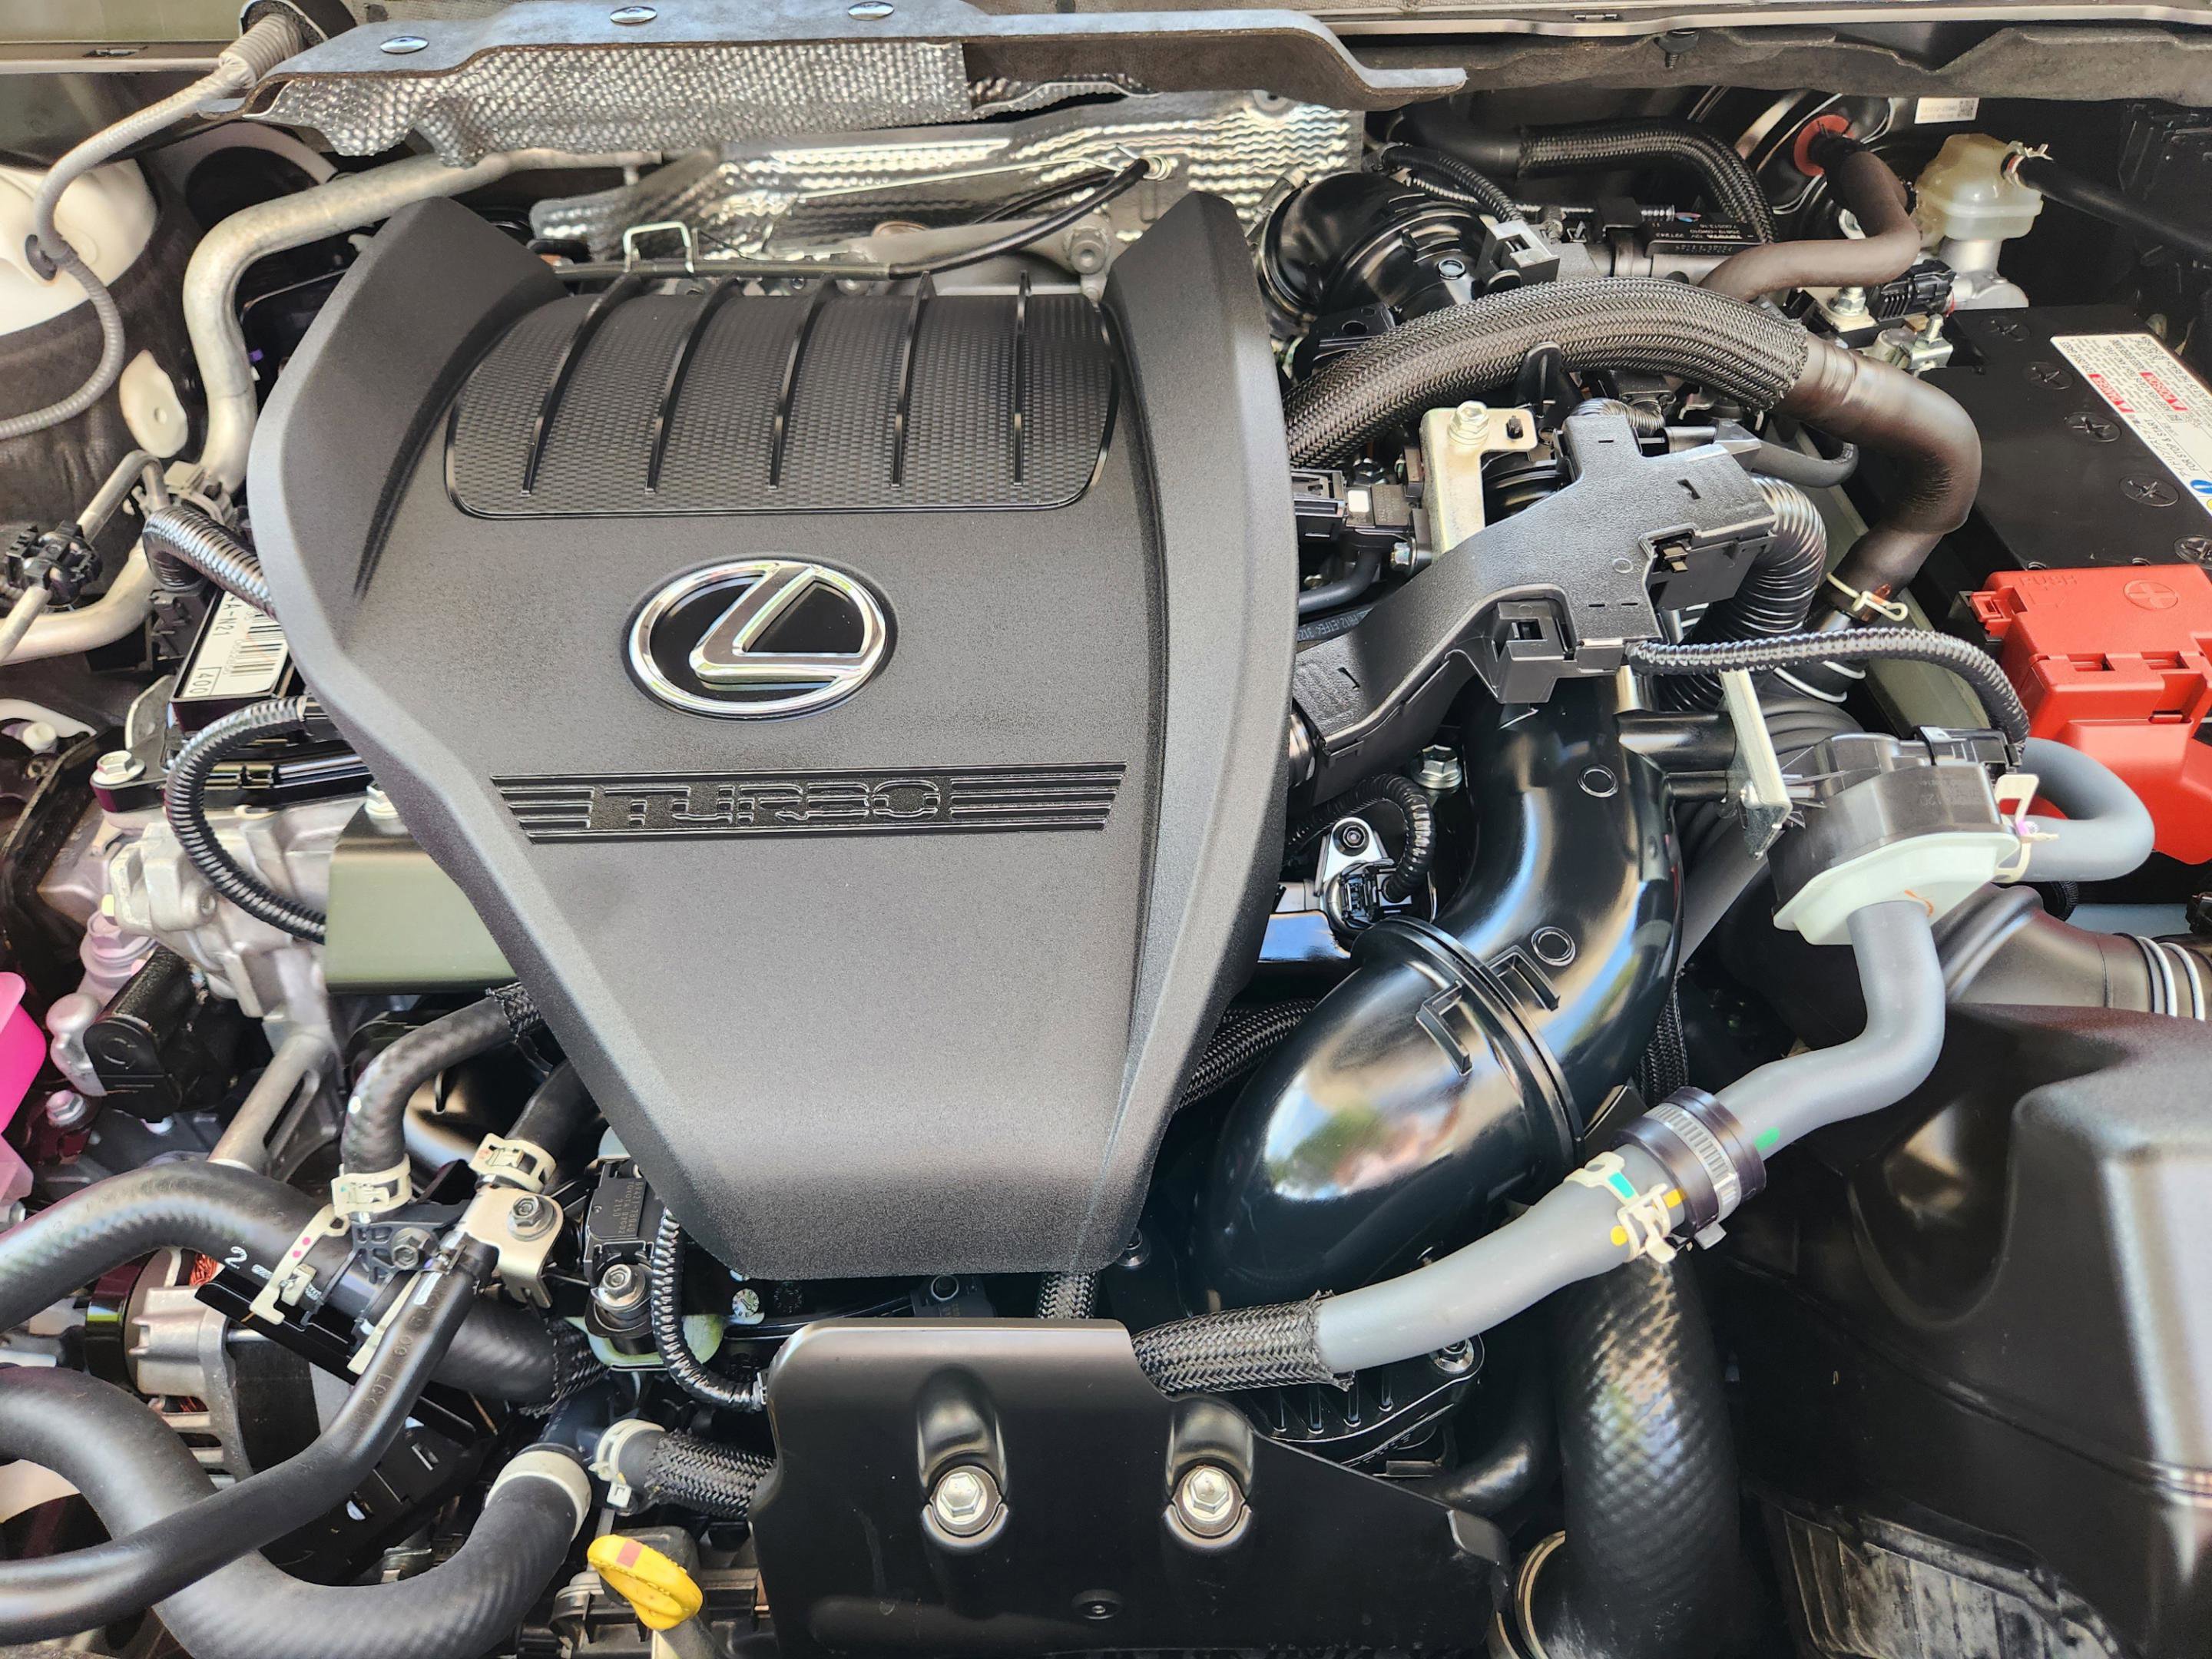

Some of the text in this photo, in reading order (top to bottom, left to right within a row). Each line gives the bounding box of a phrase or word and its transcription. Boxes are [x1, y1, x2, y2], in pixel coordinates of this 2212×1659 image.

[2141, 419, 2168, 436] START
[2164, 442, 2188, 458] STOP
[2179, 459, 2201, 472] FOR
[2018, 575, 2078, 586] PUSH
[189, 672, 214, 695] 400
[604, 779, 942, 828] TURBO
[224, 1245, 247, 1270] 2
